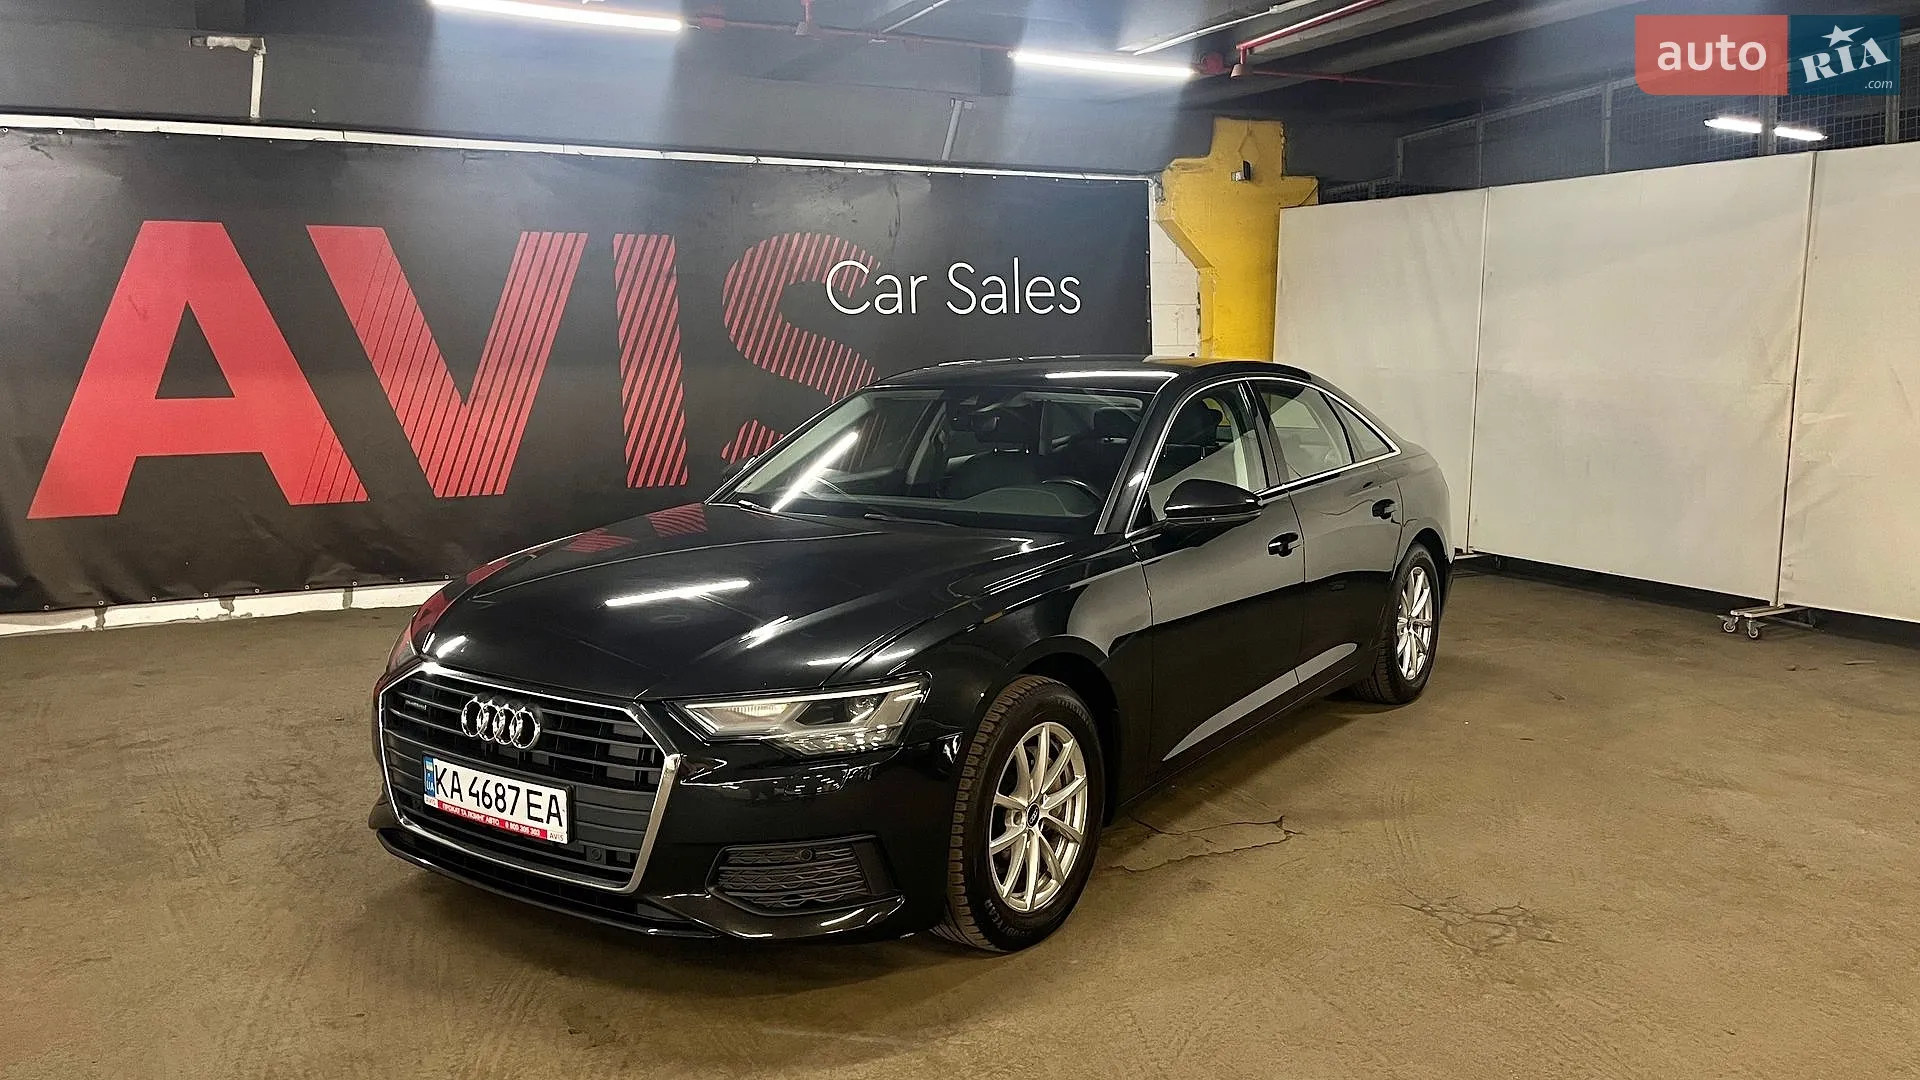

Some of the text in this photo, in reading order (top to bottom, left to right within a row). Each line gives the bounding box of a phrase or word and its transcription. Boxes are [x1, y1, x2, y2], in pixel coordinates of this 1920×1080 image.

[825, 256, 1082, 315] Car Sales
[27, 220, 881, 519] AVIS
[435, 765, 562, 827] KA 4687 EA
